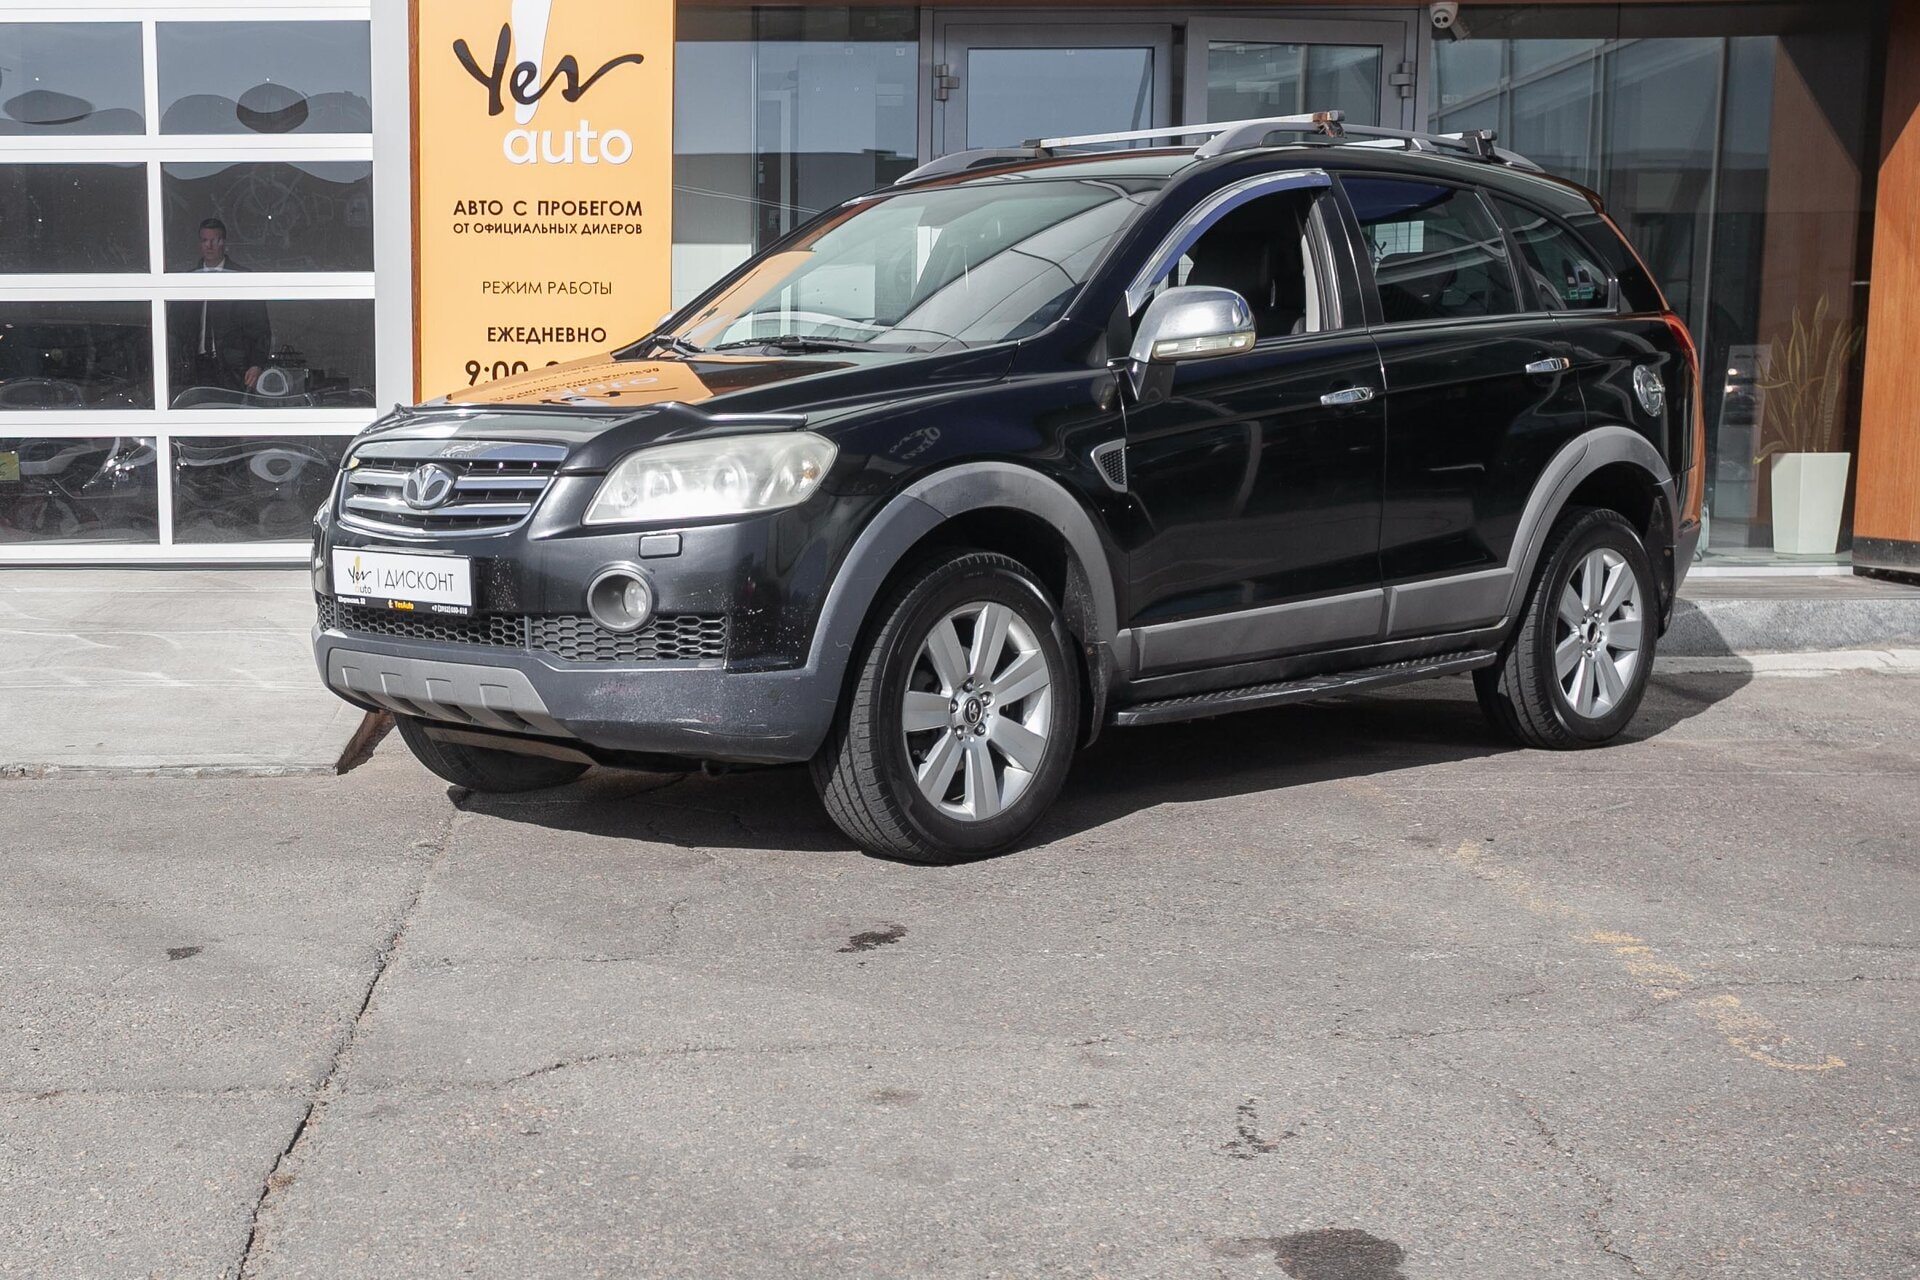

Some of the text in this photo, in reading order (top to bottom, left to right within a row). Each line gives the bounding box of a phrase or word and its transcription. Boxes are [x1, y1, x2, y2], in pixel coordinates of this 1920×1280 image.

[453, 22, 644, 116] Yes
[503, 119, 633, 165] auto
[453, 199, 642, 216] АВТО С ПРОБЕГОМ
[453, 222, 643, 236] ОТ ОФИЦИАЛЬНЫХ ДИЛЕРОВ
[482, 281, 612, 295] РЕЖИМ РАБОТЫ
[487, 326, 607, 345] ЕЖЕДНЕВНО
[384, 569, 454, 592] ДИСКОНТ
